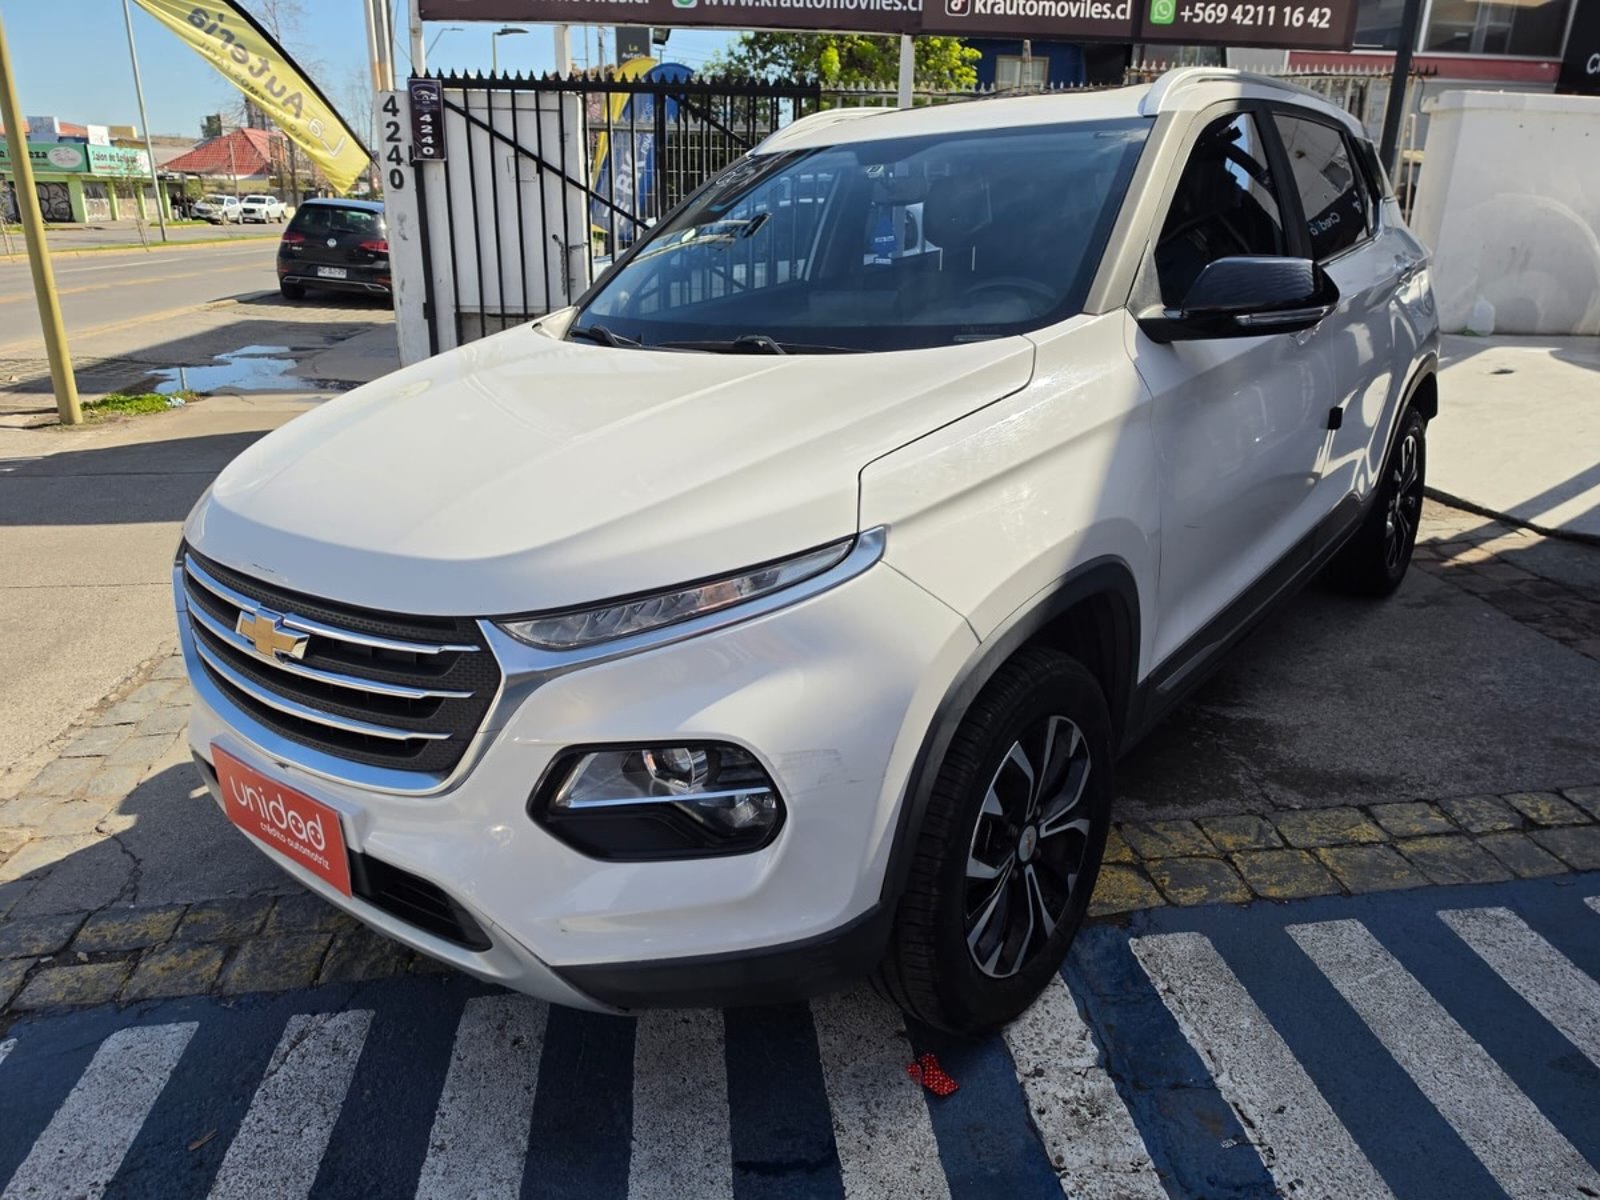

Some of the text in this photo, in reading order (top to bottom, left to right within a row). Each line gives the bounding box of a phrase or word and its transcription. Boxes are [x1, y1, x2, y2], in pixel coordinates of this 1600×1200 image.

[974, 0, 1131, 20] krautomoviles.cl
[1180, 3, 1332, 28] +569 4211 16 42
[382, 95, 405, 190] 4240
[419, 113, 435, 156] 4240
[229, 776, 325, 851] unidad
